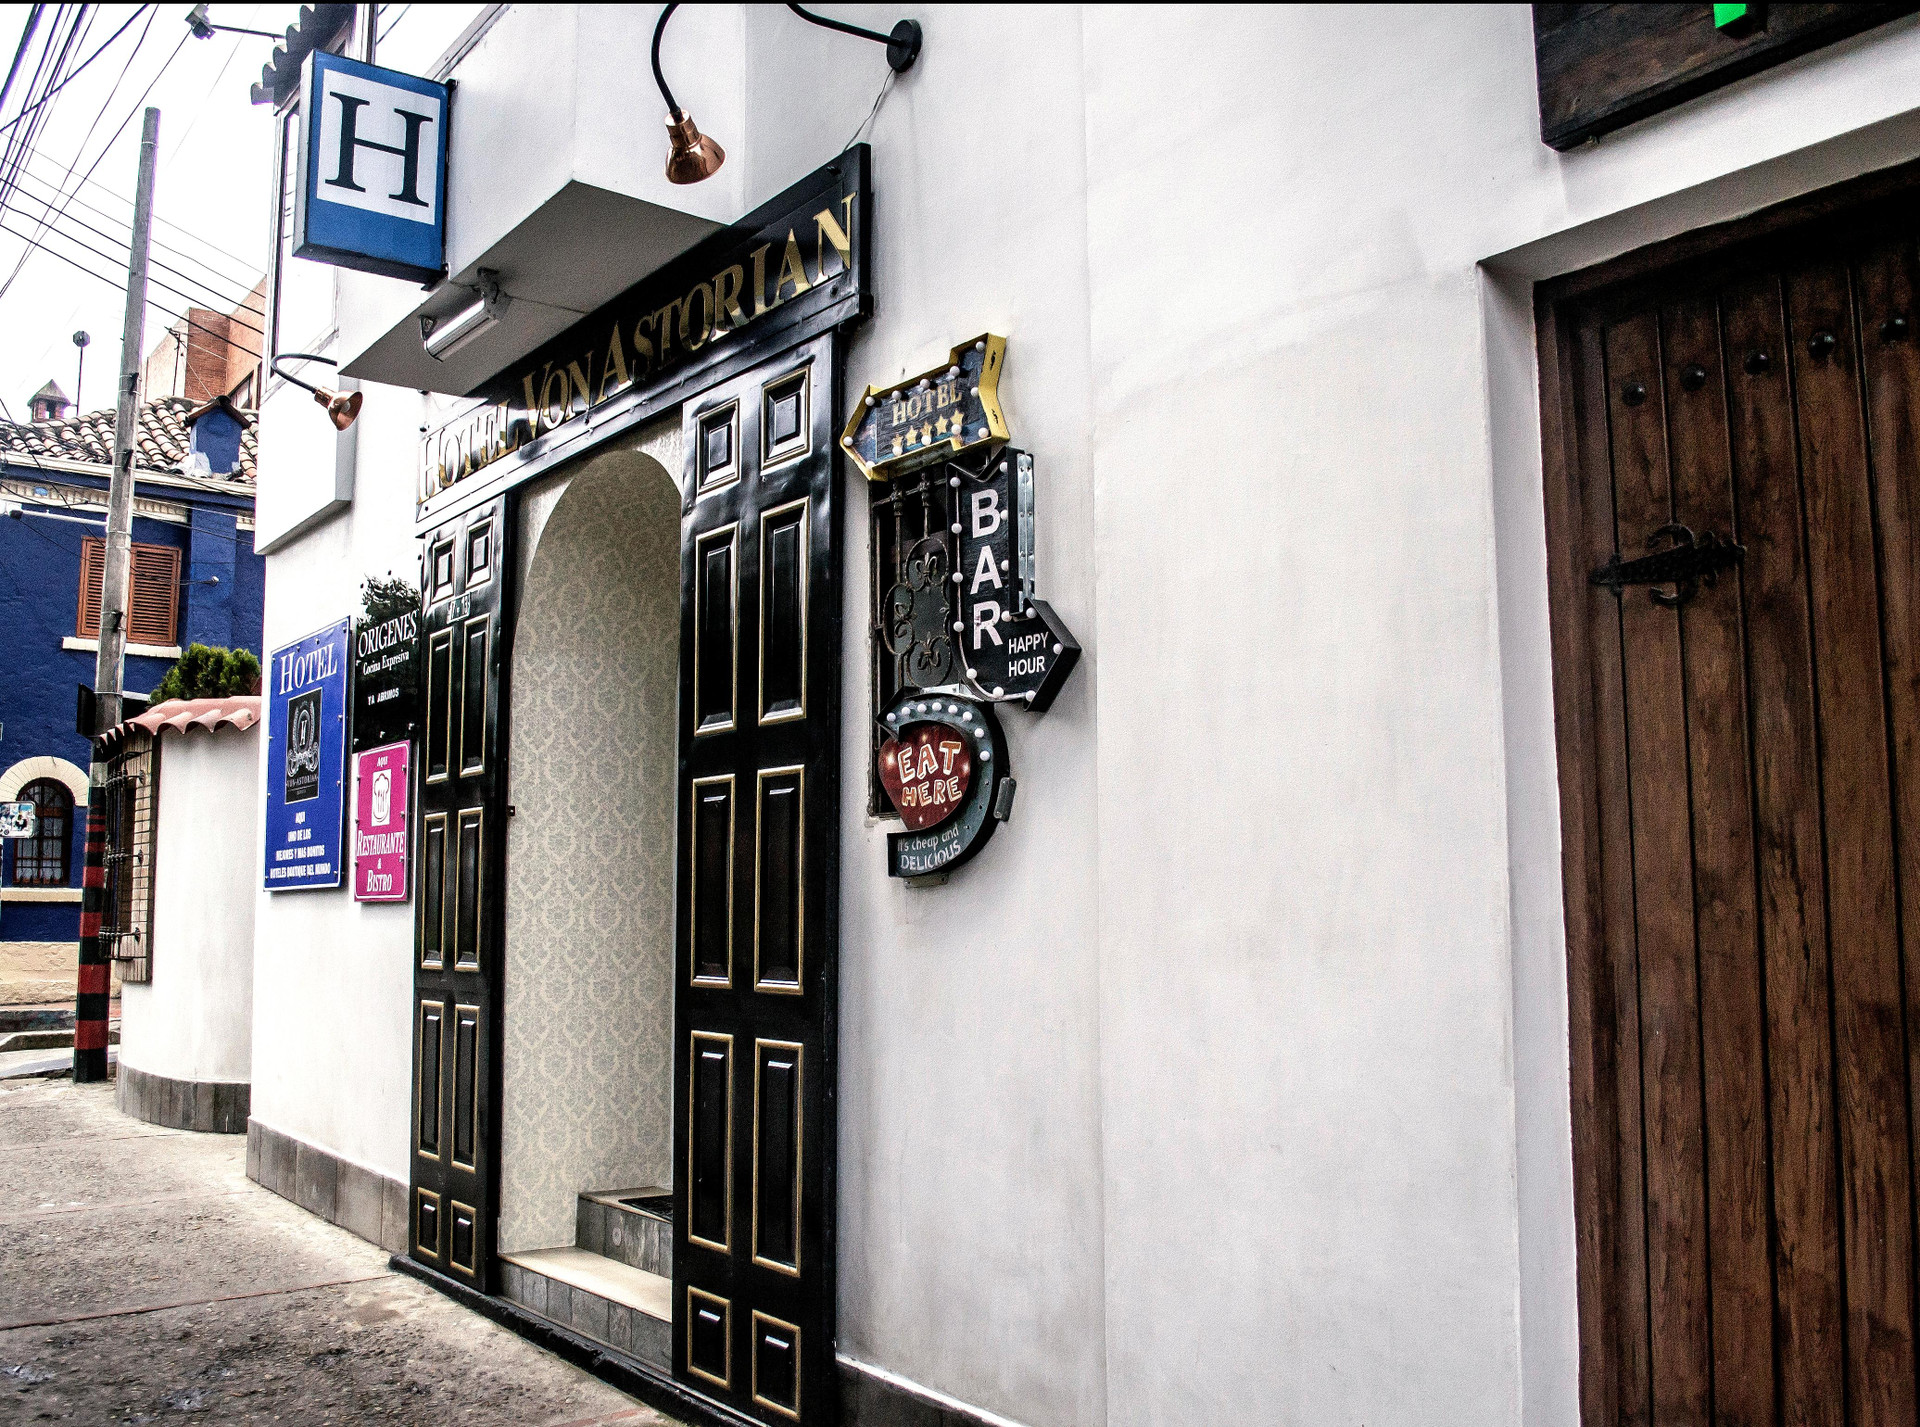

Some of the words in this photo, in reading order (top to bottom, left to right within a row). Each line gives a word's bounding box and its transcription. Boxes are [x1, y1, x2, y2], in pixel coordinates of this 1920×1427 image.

[324, 91, 433, 208] H
[417, 399, 520, 505] HOTEL
[522, 351, 594, 440] VON
[588, 192, 857, 407] ASTORIAN
[892, 378, 963, 427] HOTEL
[970, 488, 1004, 650] BAR
[358, 610, 417, 658] ORIGENES
[1008, 631, 1049, 654] HAPPY
[279, 642, 338, 695] HOTEL
[363, 660, 380, 676] Cocina
[382, 649, 410, 671] Expresiva
[1008, 655, 1045, 677] HOUR
[377, 687, 399, 703] ABRIMOS
[897, 740, 962, 783] EAT
[901, 775, 962, 807] HERE
[356, 830, 405, 857] RESTAURANTE
[911, 836, 939, 851] cheap
[941, 822, 959, 842] and
[900, 840, 961, 871] DELICIOUS
[367, 870, 392, 892] BISTRO
